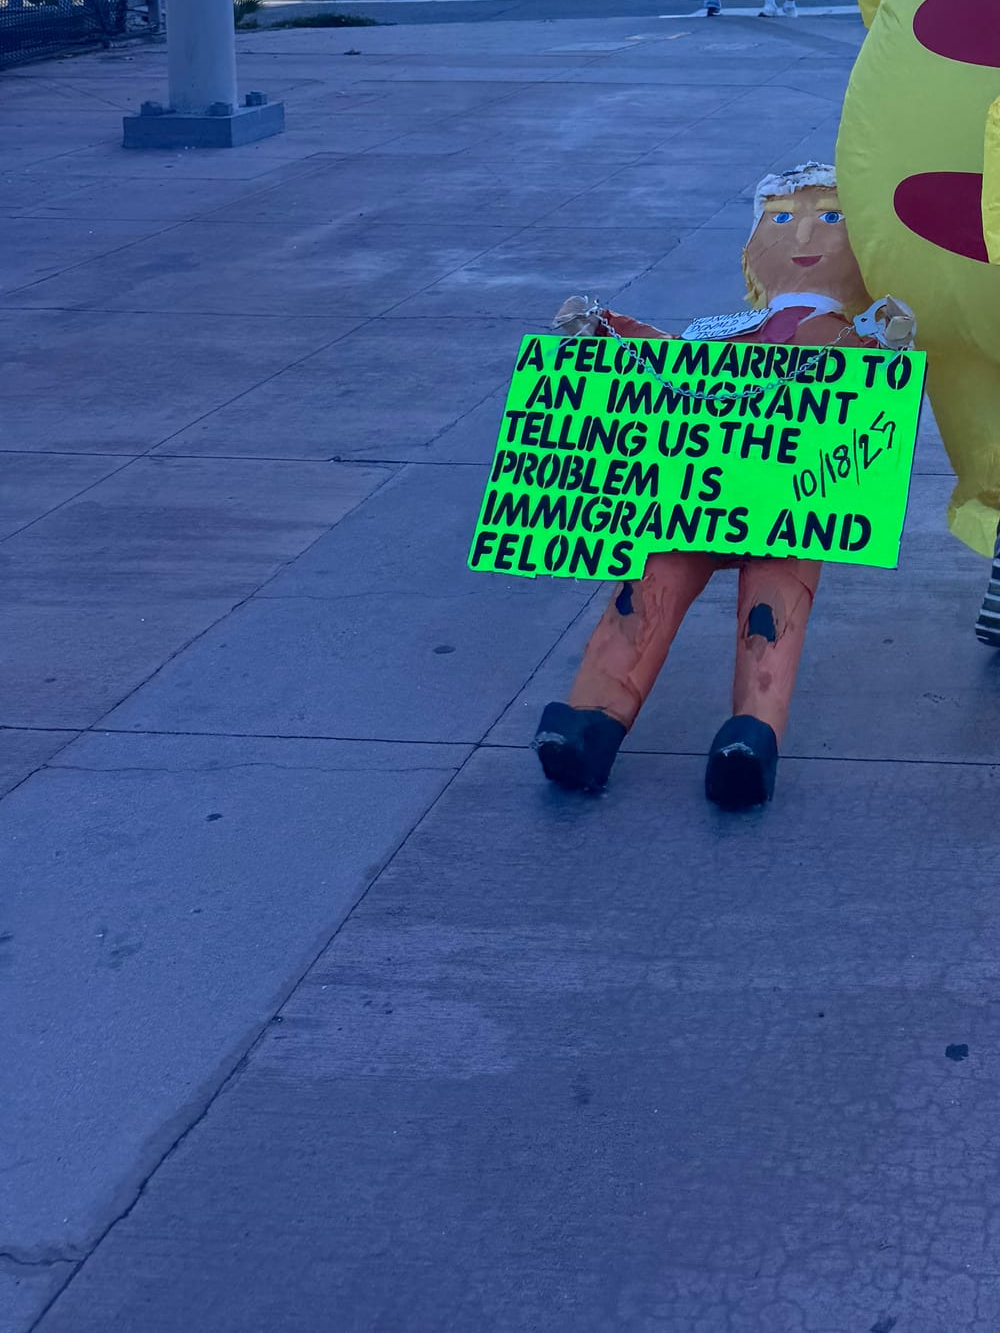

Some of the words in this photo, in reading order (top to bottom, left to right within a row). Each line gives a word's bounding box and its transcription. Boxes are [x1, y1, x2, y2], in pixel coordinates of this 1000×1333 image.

[517, 338, 544, 372] A
[554, 338, 669, 375] FELON
[672, 342, 847, 384] MARRIED
[862, 353, 912, 390] TO
[526, 376, 587, 411] AN
[606, 379, 859, 425] IMMIGRANT
[505, 410, 648, 458] TELLING
[658, 421, 710, 458] US
[720, 421, 801, 464] THE
[792, 411, 896, 502] 10/18/25
[492, 450, 660, 497] PROBLEM
[681, 463, 723, 501] IS
[483, 490, 749, 543] IMMIGRANTS
[767, 509, 872, 552] AND
[472, 532, 634, 577] FELONS
